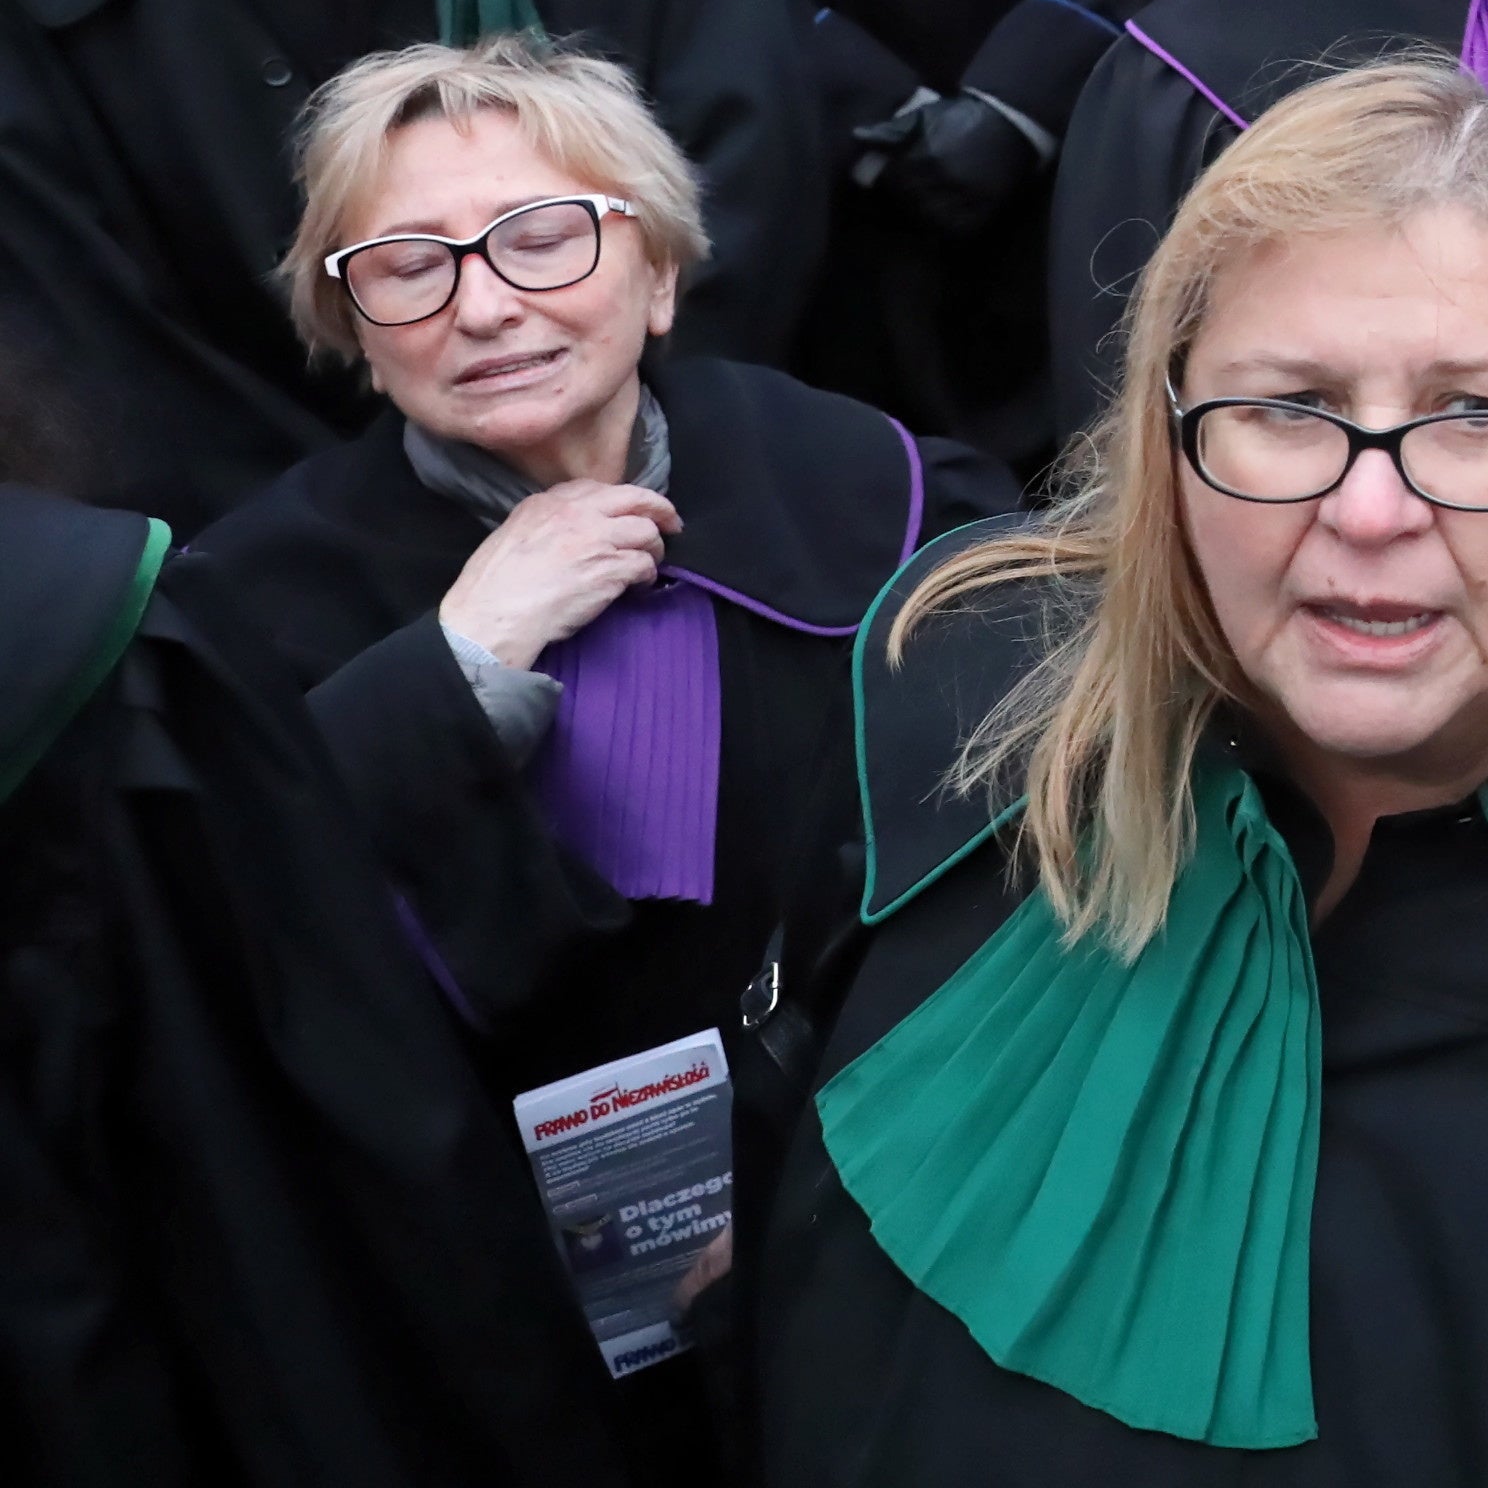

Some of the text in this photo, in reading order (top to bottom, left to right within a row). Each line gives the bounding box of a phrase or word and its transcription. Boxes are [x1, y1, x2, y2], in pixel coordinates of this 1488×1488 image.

[533, 1109, 589, 1141] PRAWO
[590, 1101, 611, 1120] DO
[625, 1203, 702, 1239] o tym
